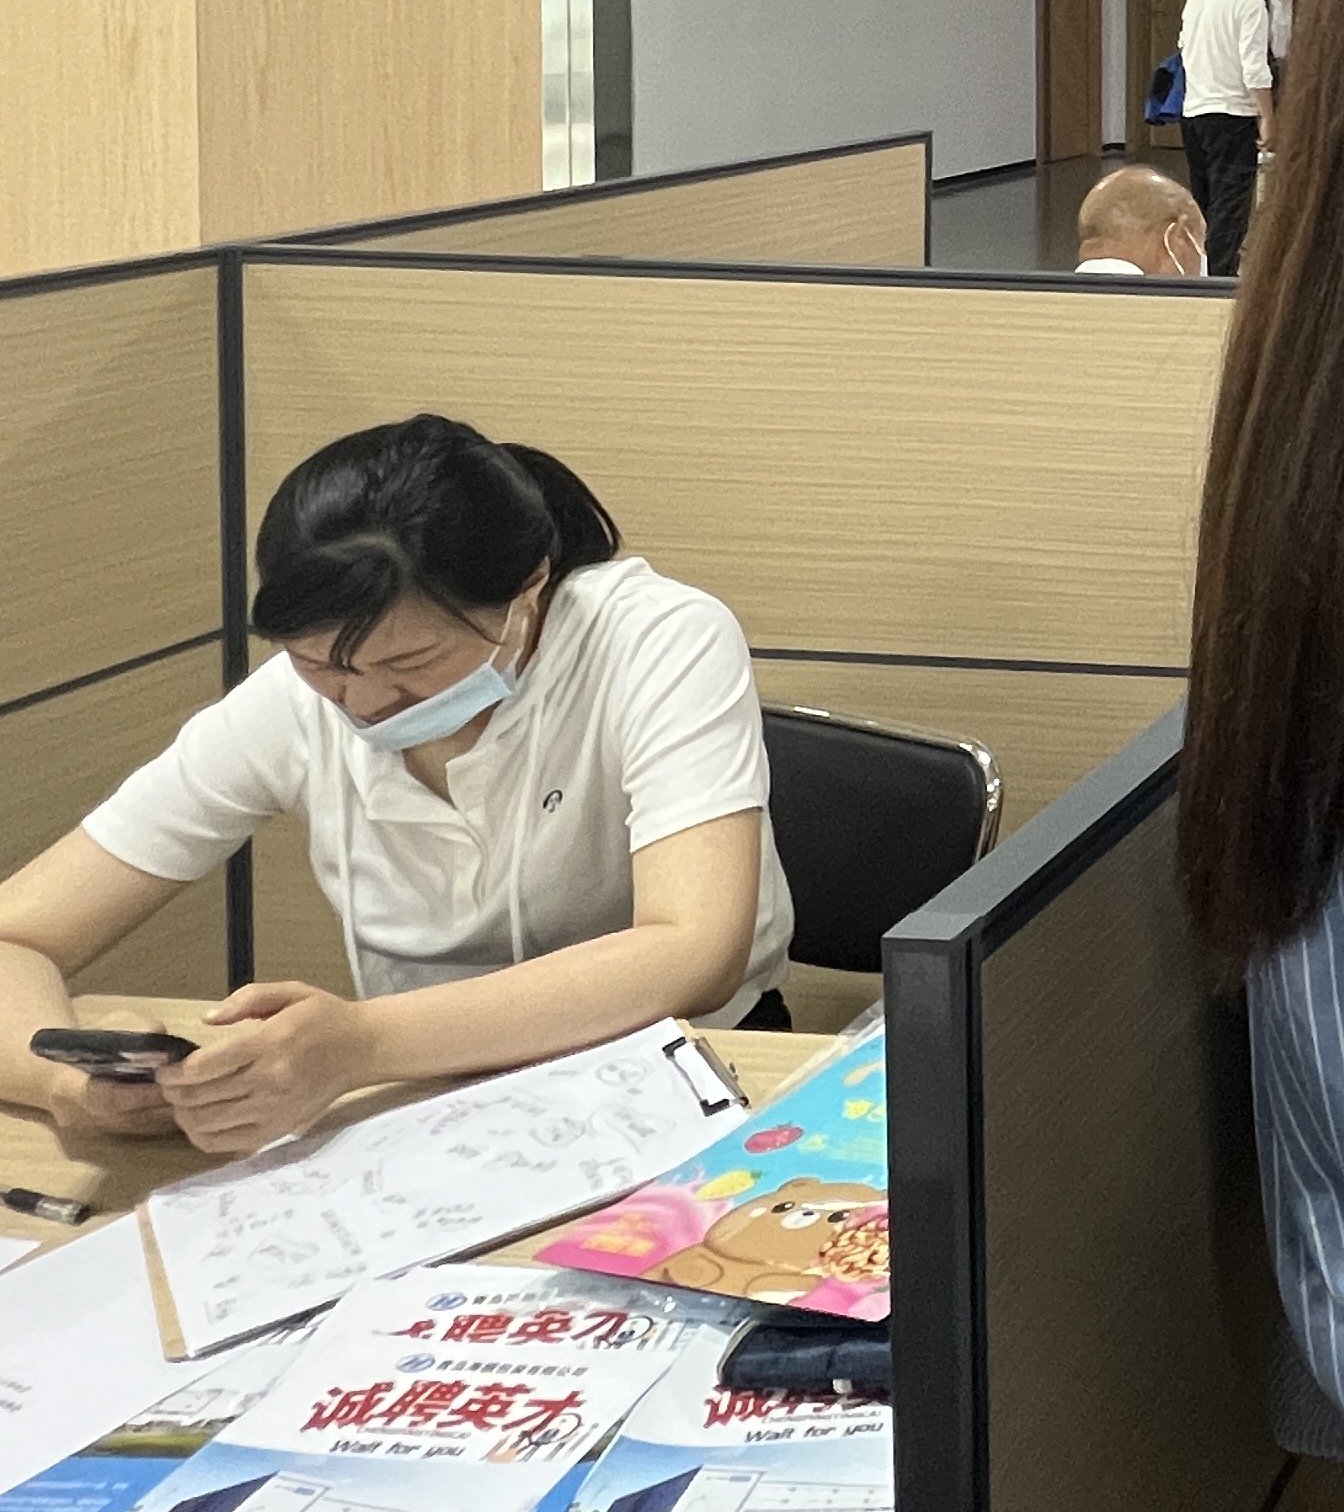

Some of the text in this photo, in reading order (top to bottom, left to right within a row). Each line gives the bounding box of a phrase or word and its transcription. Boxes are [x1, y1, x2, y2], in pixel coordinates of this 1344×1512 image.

[299, 1379, 586, 1433] 诚聘英才
[804, 1424, 837, 1439] for
[843, 1421, 885, 1438] you
[385, 1440, 422, 1455] for
[421, 1445, 467, 1460] you
